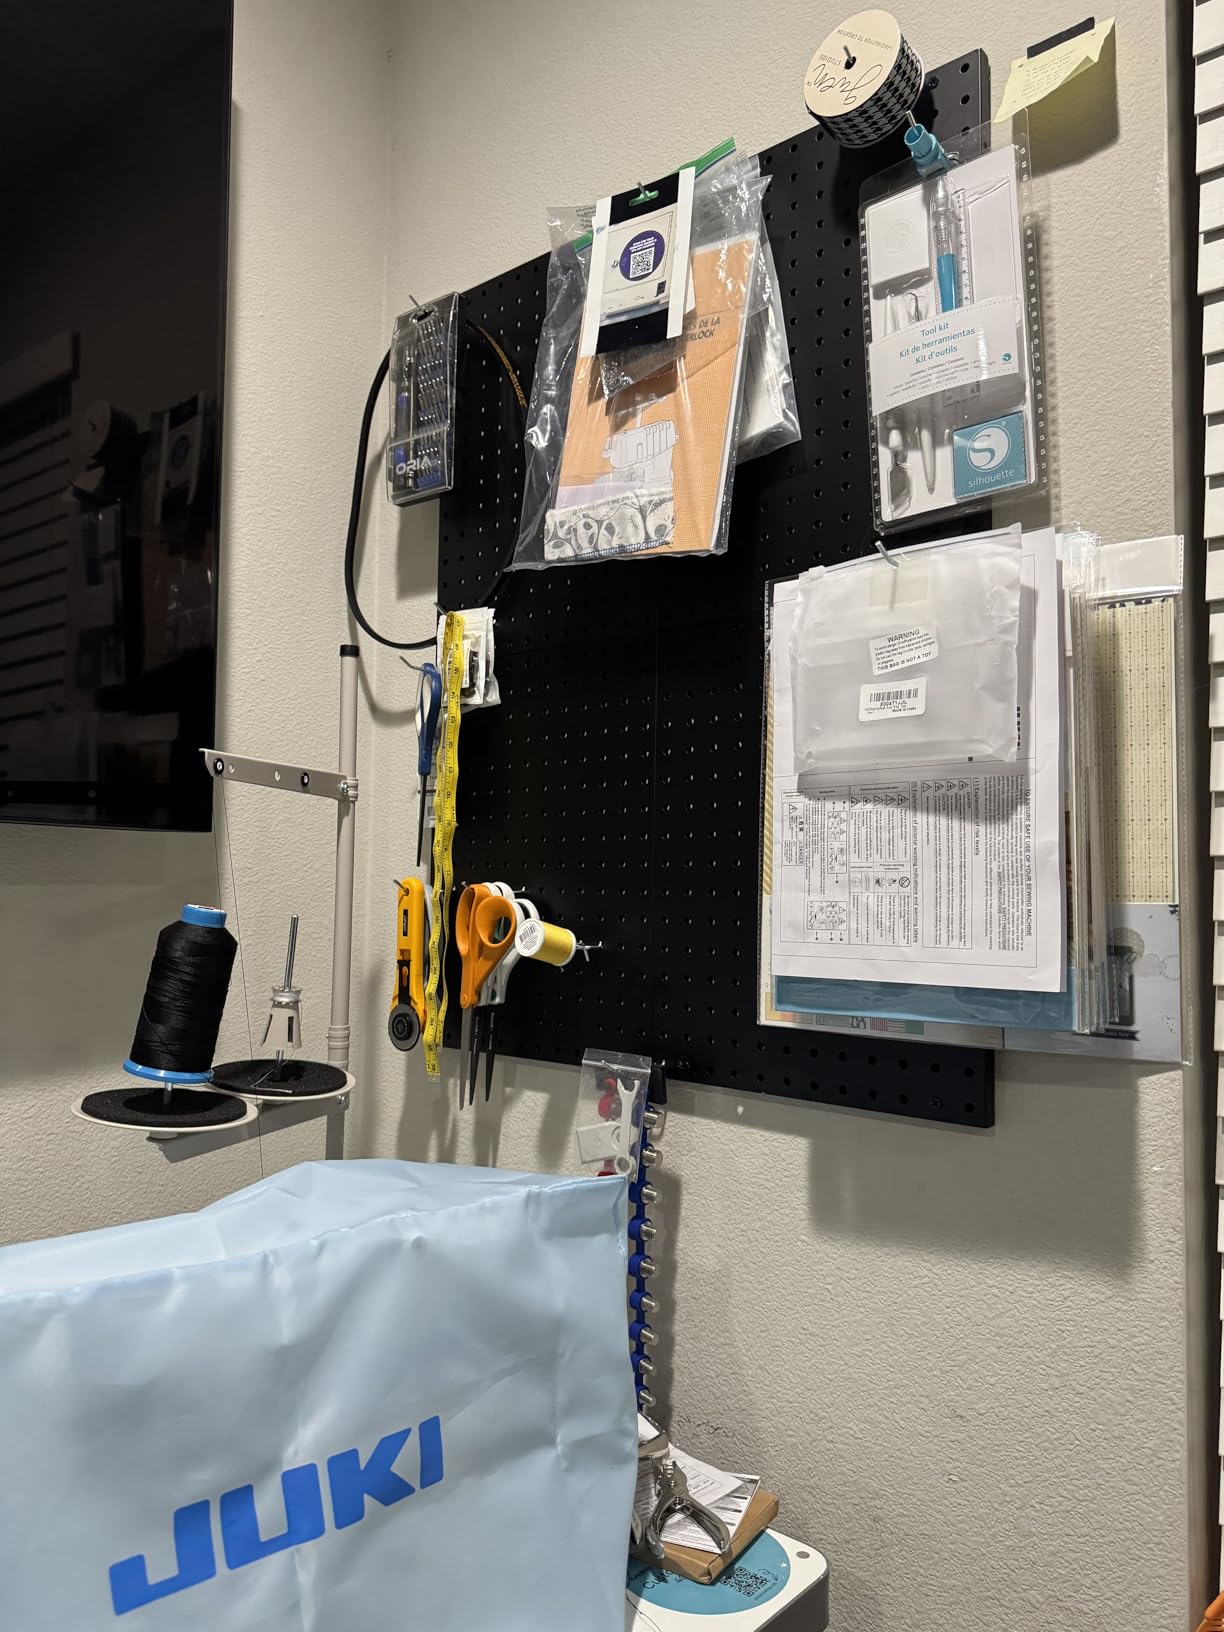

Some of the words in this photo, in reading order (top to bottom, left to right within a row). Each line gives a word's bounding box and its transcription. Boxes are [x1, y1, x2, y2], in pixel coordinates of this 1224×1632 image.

[818, 54, 842, 67] STUDIOS
[813, 64, 882, 106] gwen
[699, 319, 708, 328] DE
[711, 316, 720, 326] LA
[920, 325, 938, 337] Tool
[938, 322, 950, 332] kit
[900, 350, 910, 358] Kit
[911, 345, 920, 354] de
[922, 328, 976, 350] herramientas
[915, 355, 927, 364] Kit
[928, 345, 958, 360] d'outils
[396, 456, 432, 475] ORIA
[968, 468, 1014, 488] silhouette
[886, 629, 920, 642] WARNING
[1026, 854, 1031, 863] OF
[108, 1415, 444, 1616] JUKI
